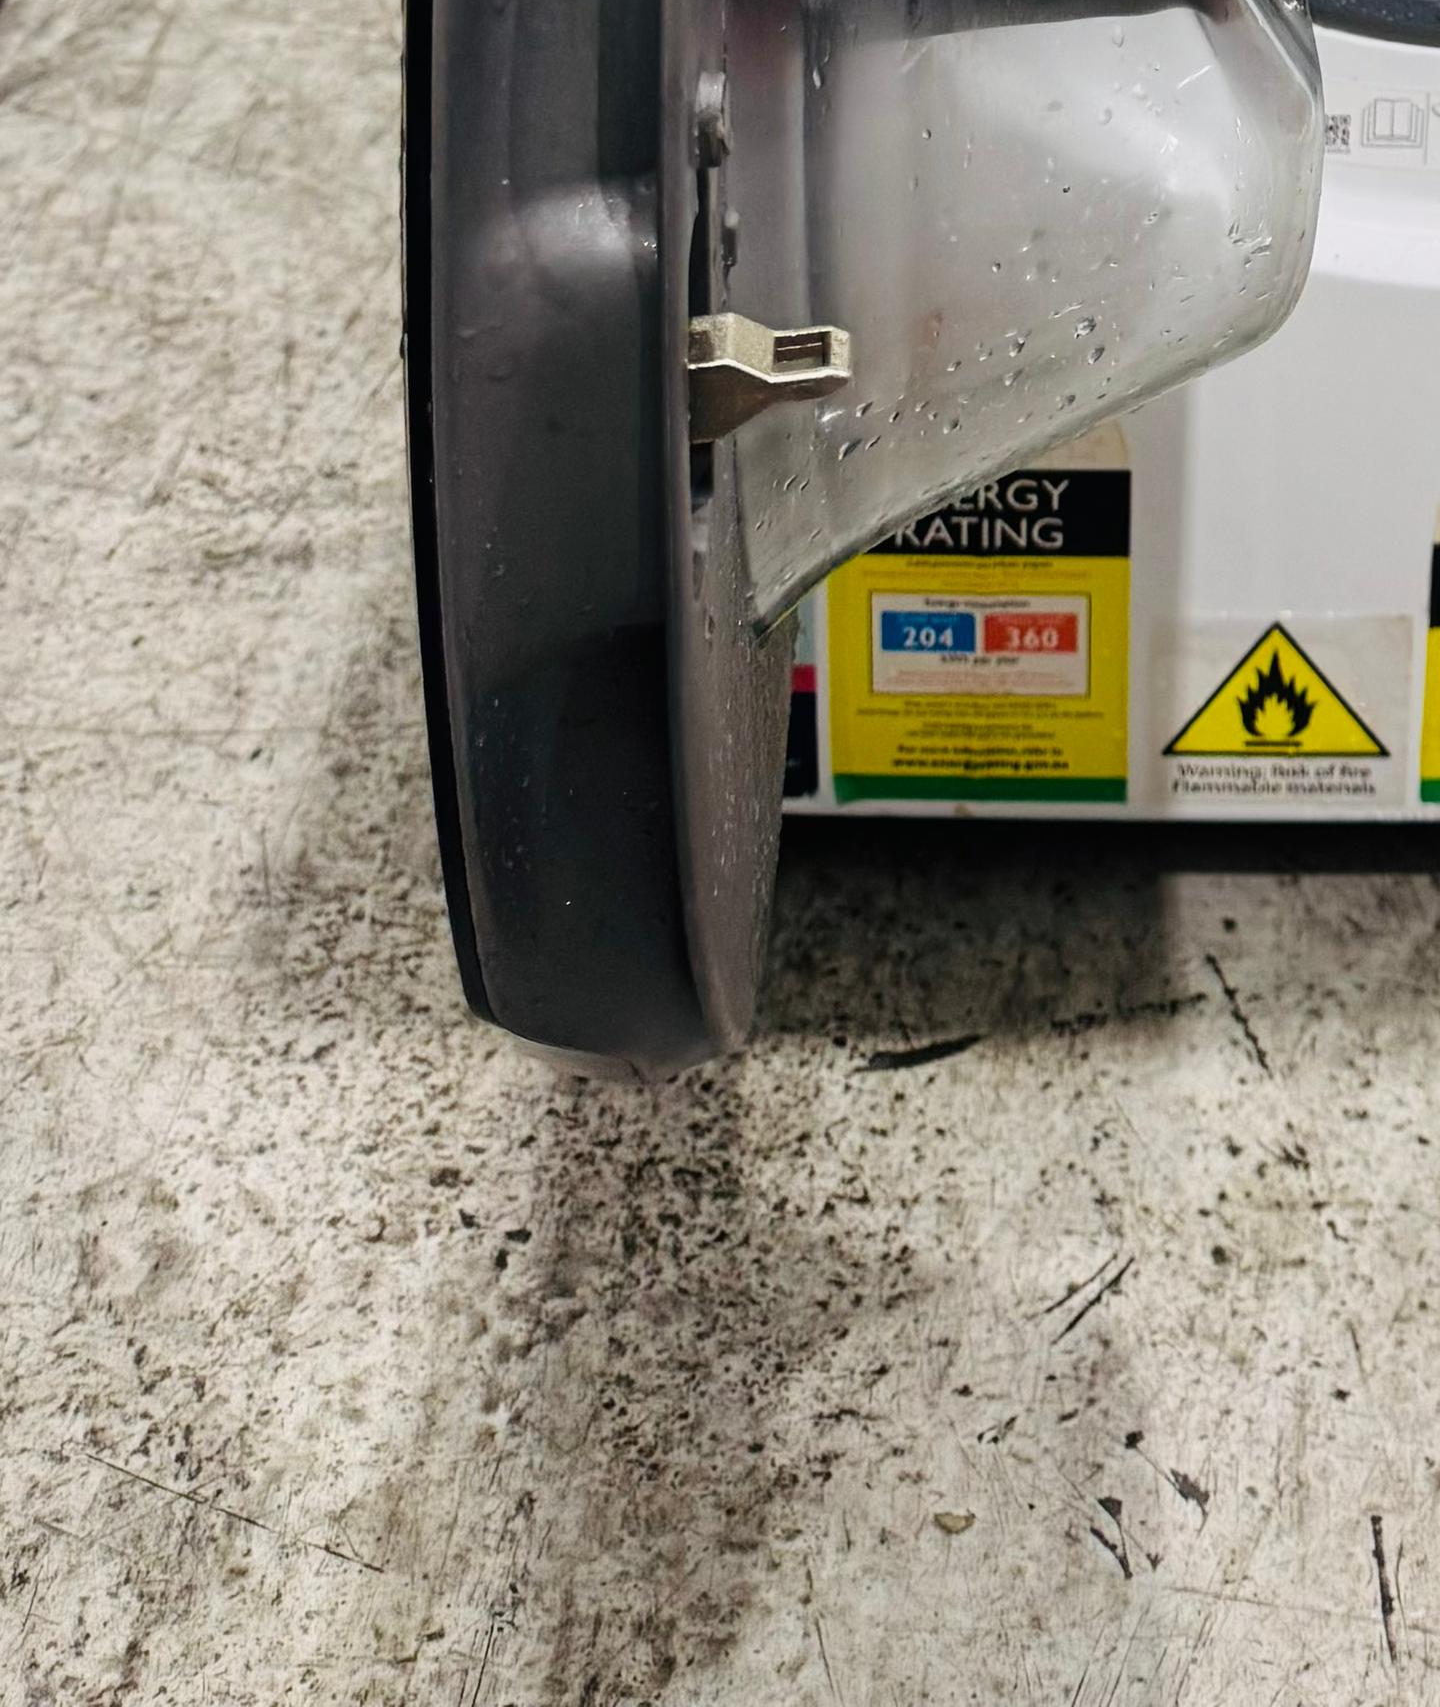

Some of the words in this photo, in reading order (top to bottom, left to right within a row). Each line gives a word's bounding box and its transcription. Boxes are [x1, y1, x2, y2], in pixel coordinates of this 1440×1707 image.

[895, 516, 1064, 550] RATING
[902, 625, 954, 649] 204
[1006, 626, 1060, 650] 360
